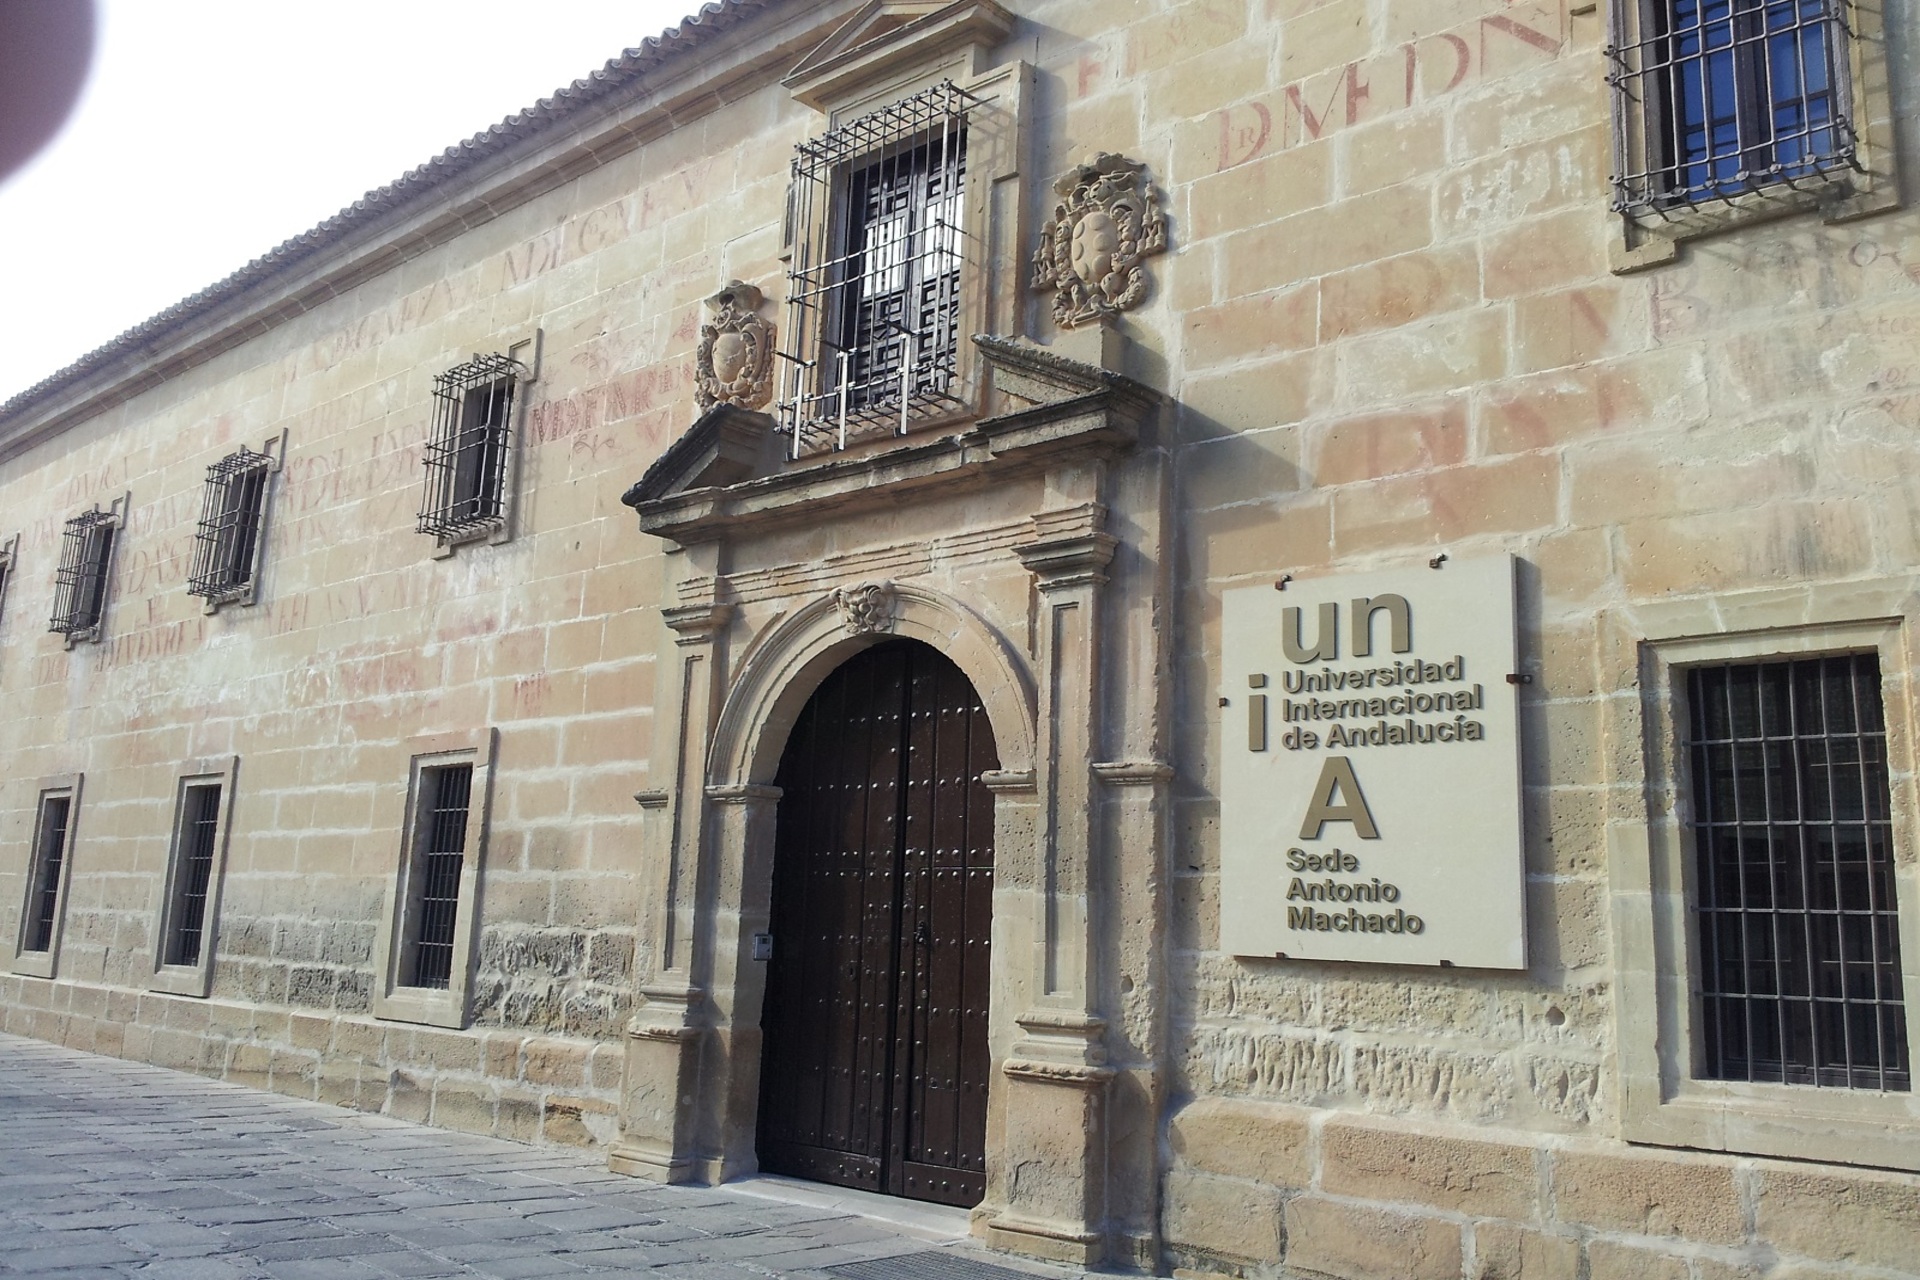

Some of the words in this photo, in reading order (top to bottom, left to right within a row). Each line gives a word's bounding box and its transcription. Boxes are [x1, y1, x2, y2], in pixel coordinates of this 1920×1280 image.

[1282, 592, 1411, 664] un
[1282, 655, 1464, 694] Universidad
[1282, 683, 1483, 722] Internacional
[1281, 726, 1318, 750] de
[1325, 714, 1484, 748] Andalucía
[1298, 755, 1381, 841] A
[1286, 847, 1360, 872] Sede
[1286, 877, 1399, 903] Antonio
[1286, 906, 1425, 934] Machado
